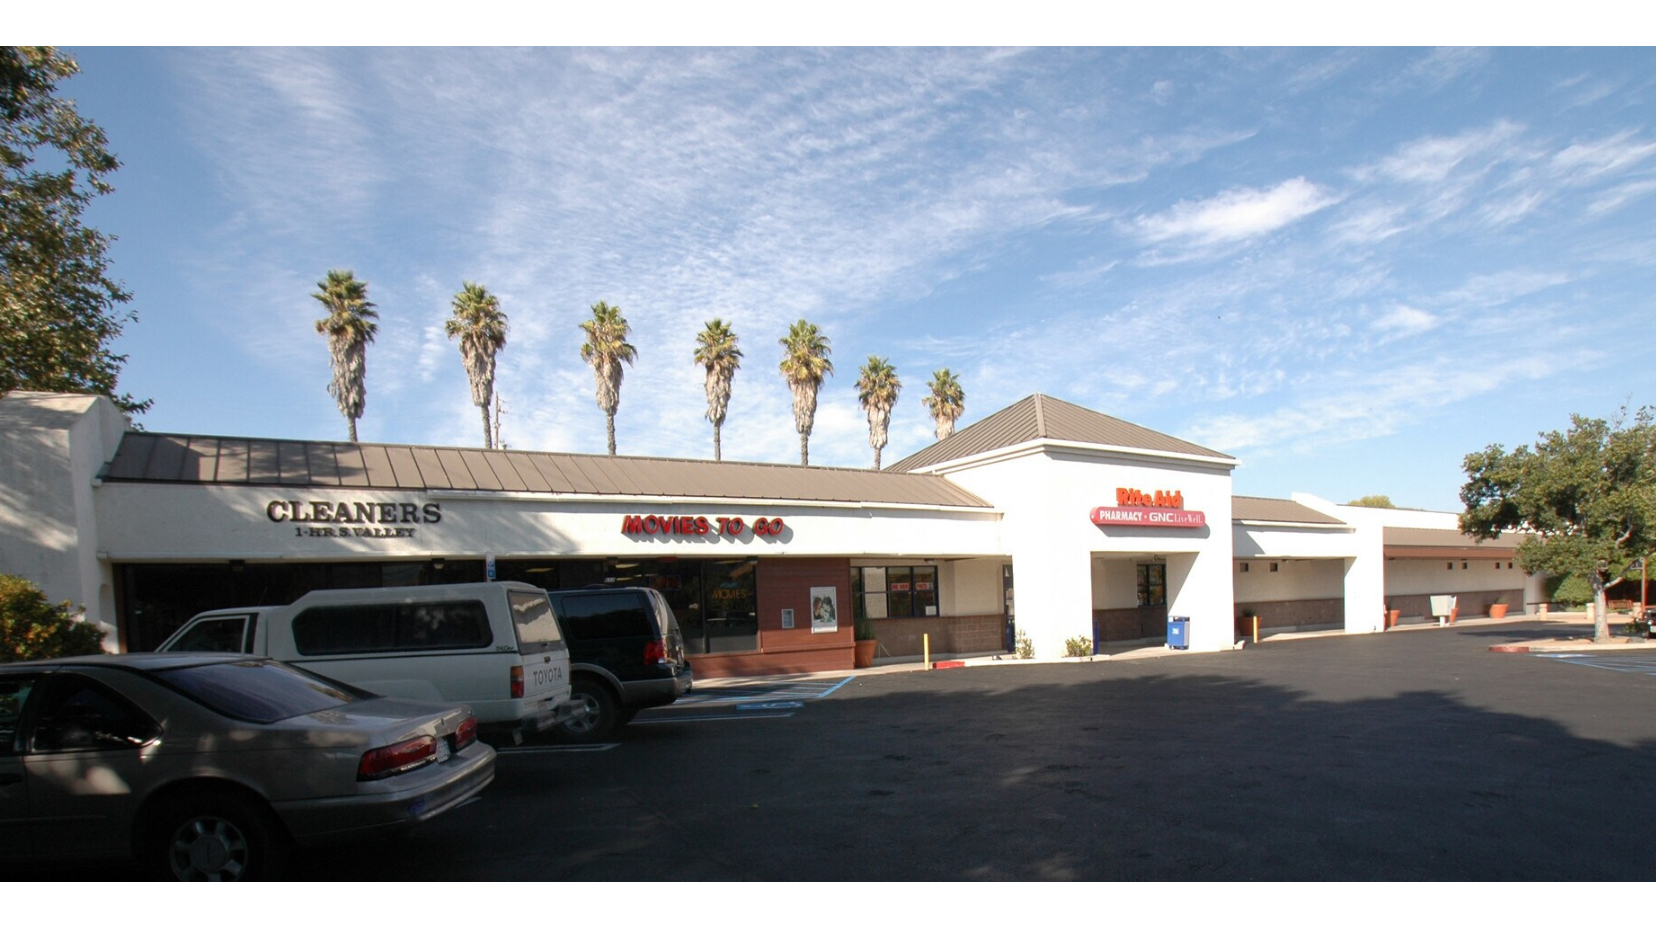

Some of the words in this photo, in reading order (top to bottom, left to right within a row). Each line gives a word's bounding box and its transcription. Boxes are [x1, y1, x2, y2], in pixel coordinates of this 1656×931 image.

[1116, 488, 1152, 507] Rite
[1153, 490, 1182, 508] Aid
[266, 500, 442, 523] CLEANERS
[1099, 510, 1143, 522] PHARMACY
[1149, 512, 1174, 522] GNC
[354, 527, 417, 538] VALLEY
[621, 514, 709, 535] MOVIES
[716, 517, 744, 535] TO
[753, 517, 784, 535] GO
[711, 589, 747, 600] MOVIES
[533, 667, 562, 686] TOYOTA
